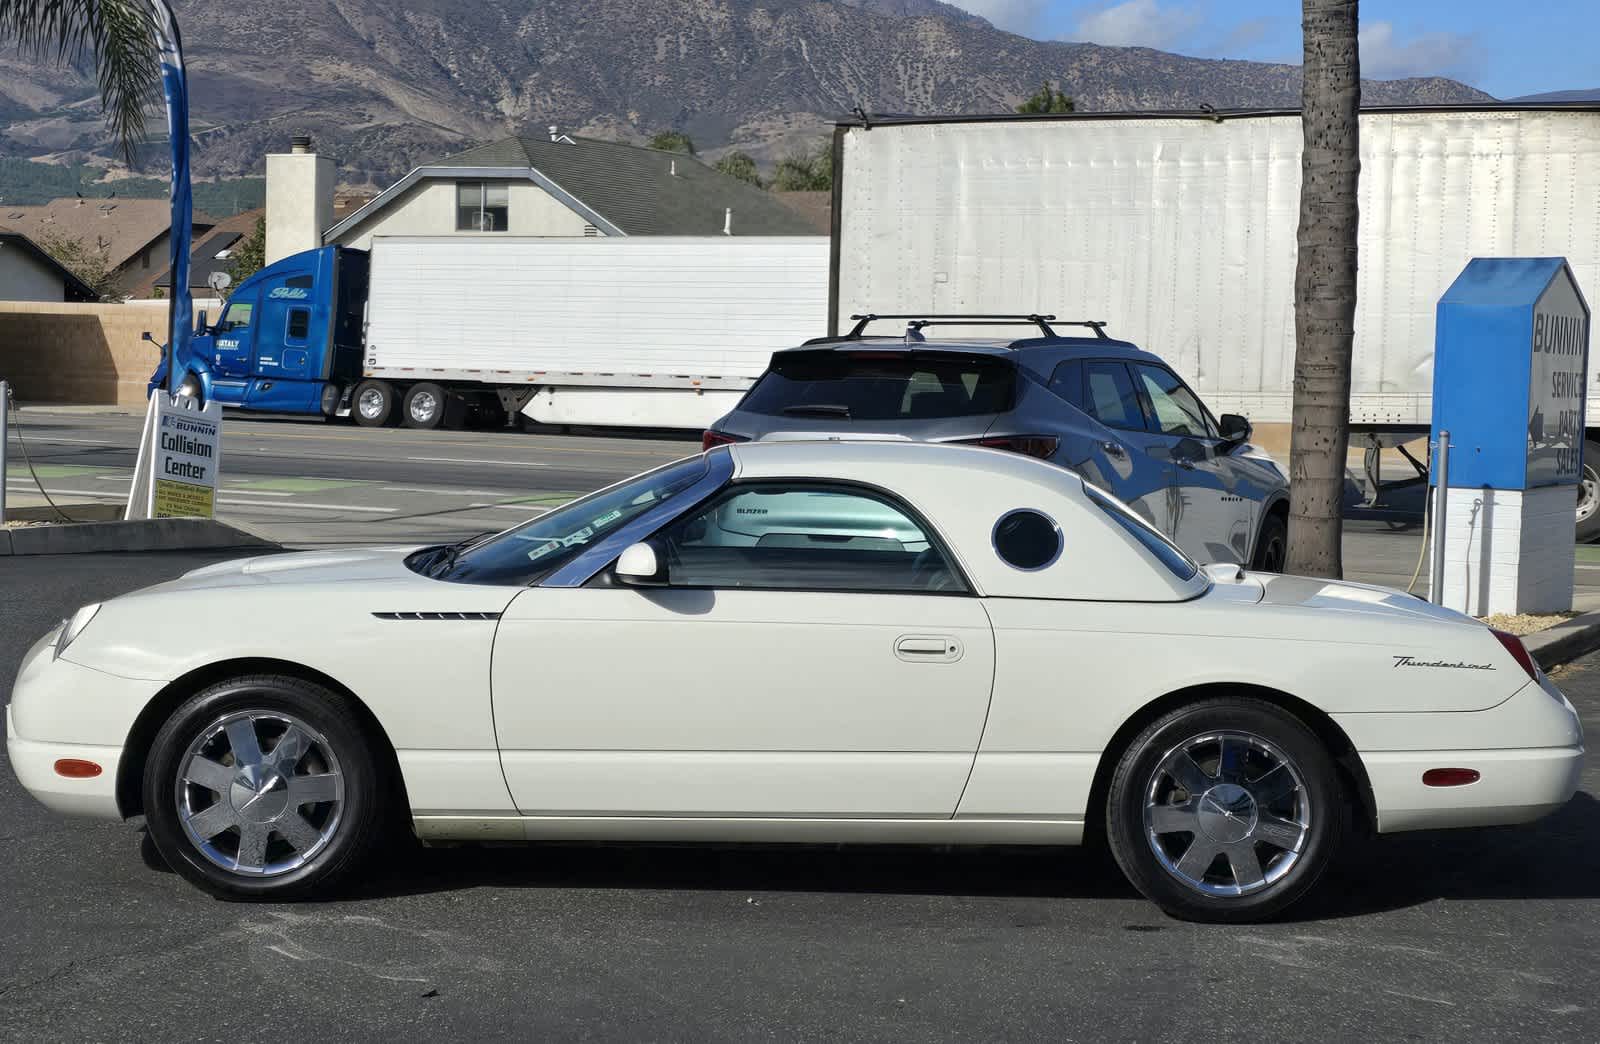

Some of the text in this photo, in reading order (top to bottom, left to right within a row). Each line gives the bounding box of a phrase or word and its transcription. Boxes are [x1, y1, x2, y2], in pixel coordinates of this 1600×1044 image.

[1534, 312, 1584, 356] BUNNIN
[176, 422, 216, 436] BUNNIN
[161, 432, 212, 458] Collision
[165, 456, 206, 479] Center
[1556, 448, 1579, 475] SALES
[1393, 655, 1497, 670] Thunderbird
